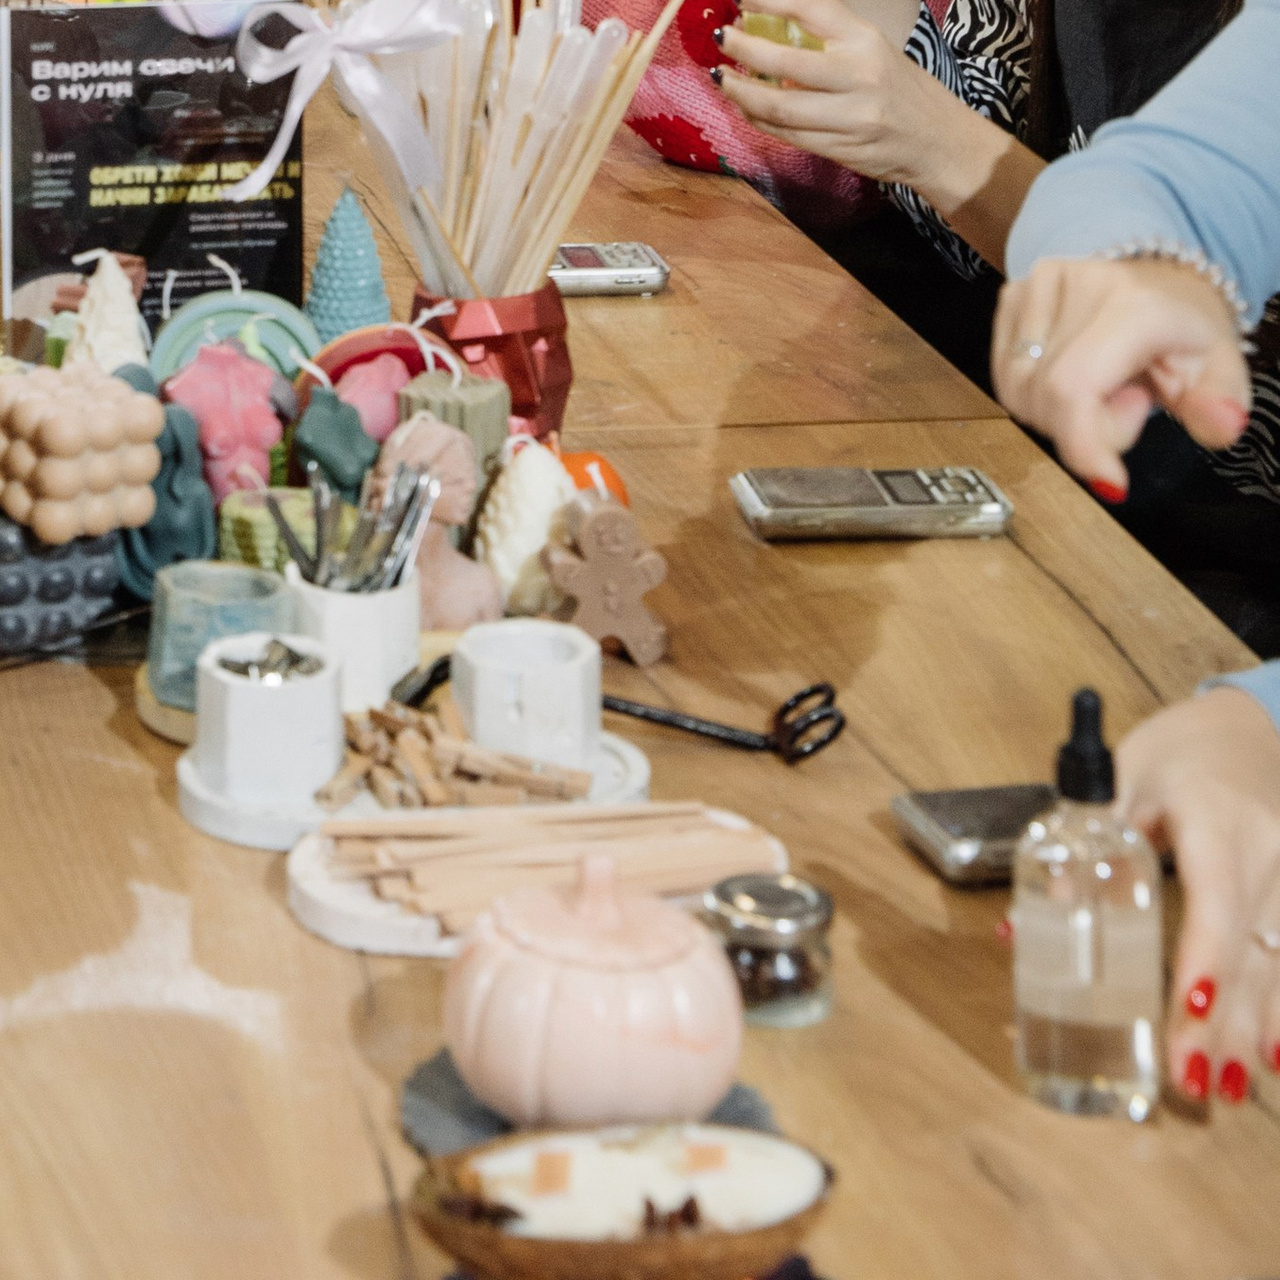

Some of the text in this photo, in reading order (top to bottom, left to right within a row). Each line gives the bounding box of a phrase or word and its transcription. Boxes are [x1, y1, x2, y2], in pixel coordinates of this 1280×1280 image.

[31, 60, 133, 81] Варим
[31, 81, 133, 103] с нуля
